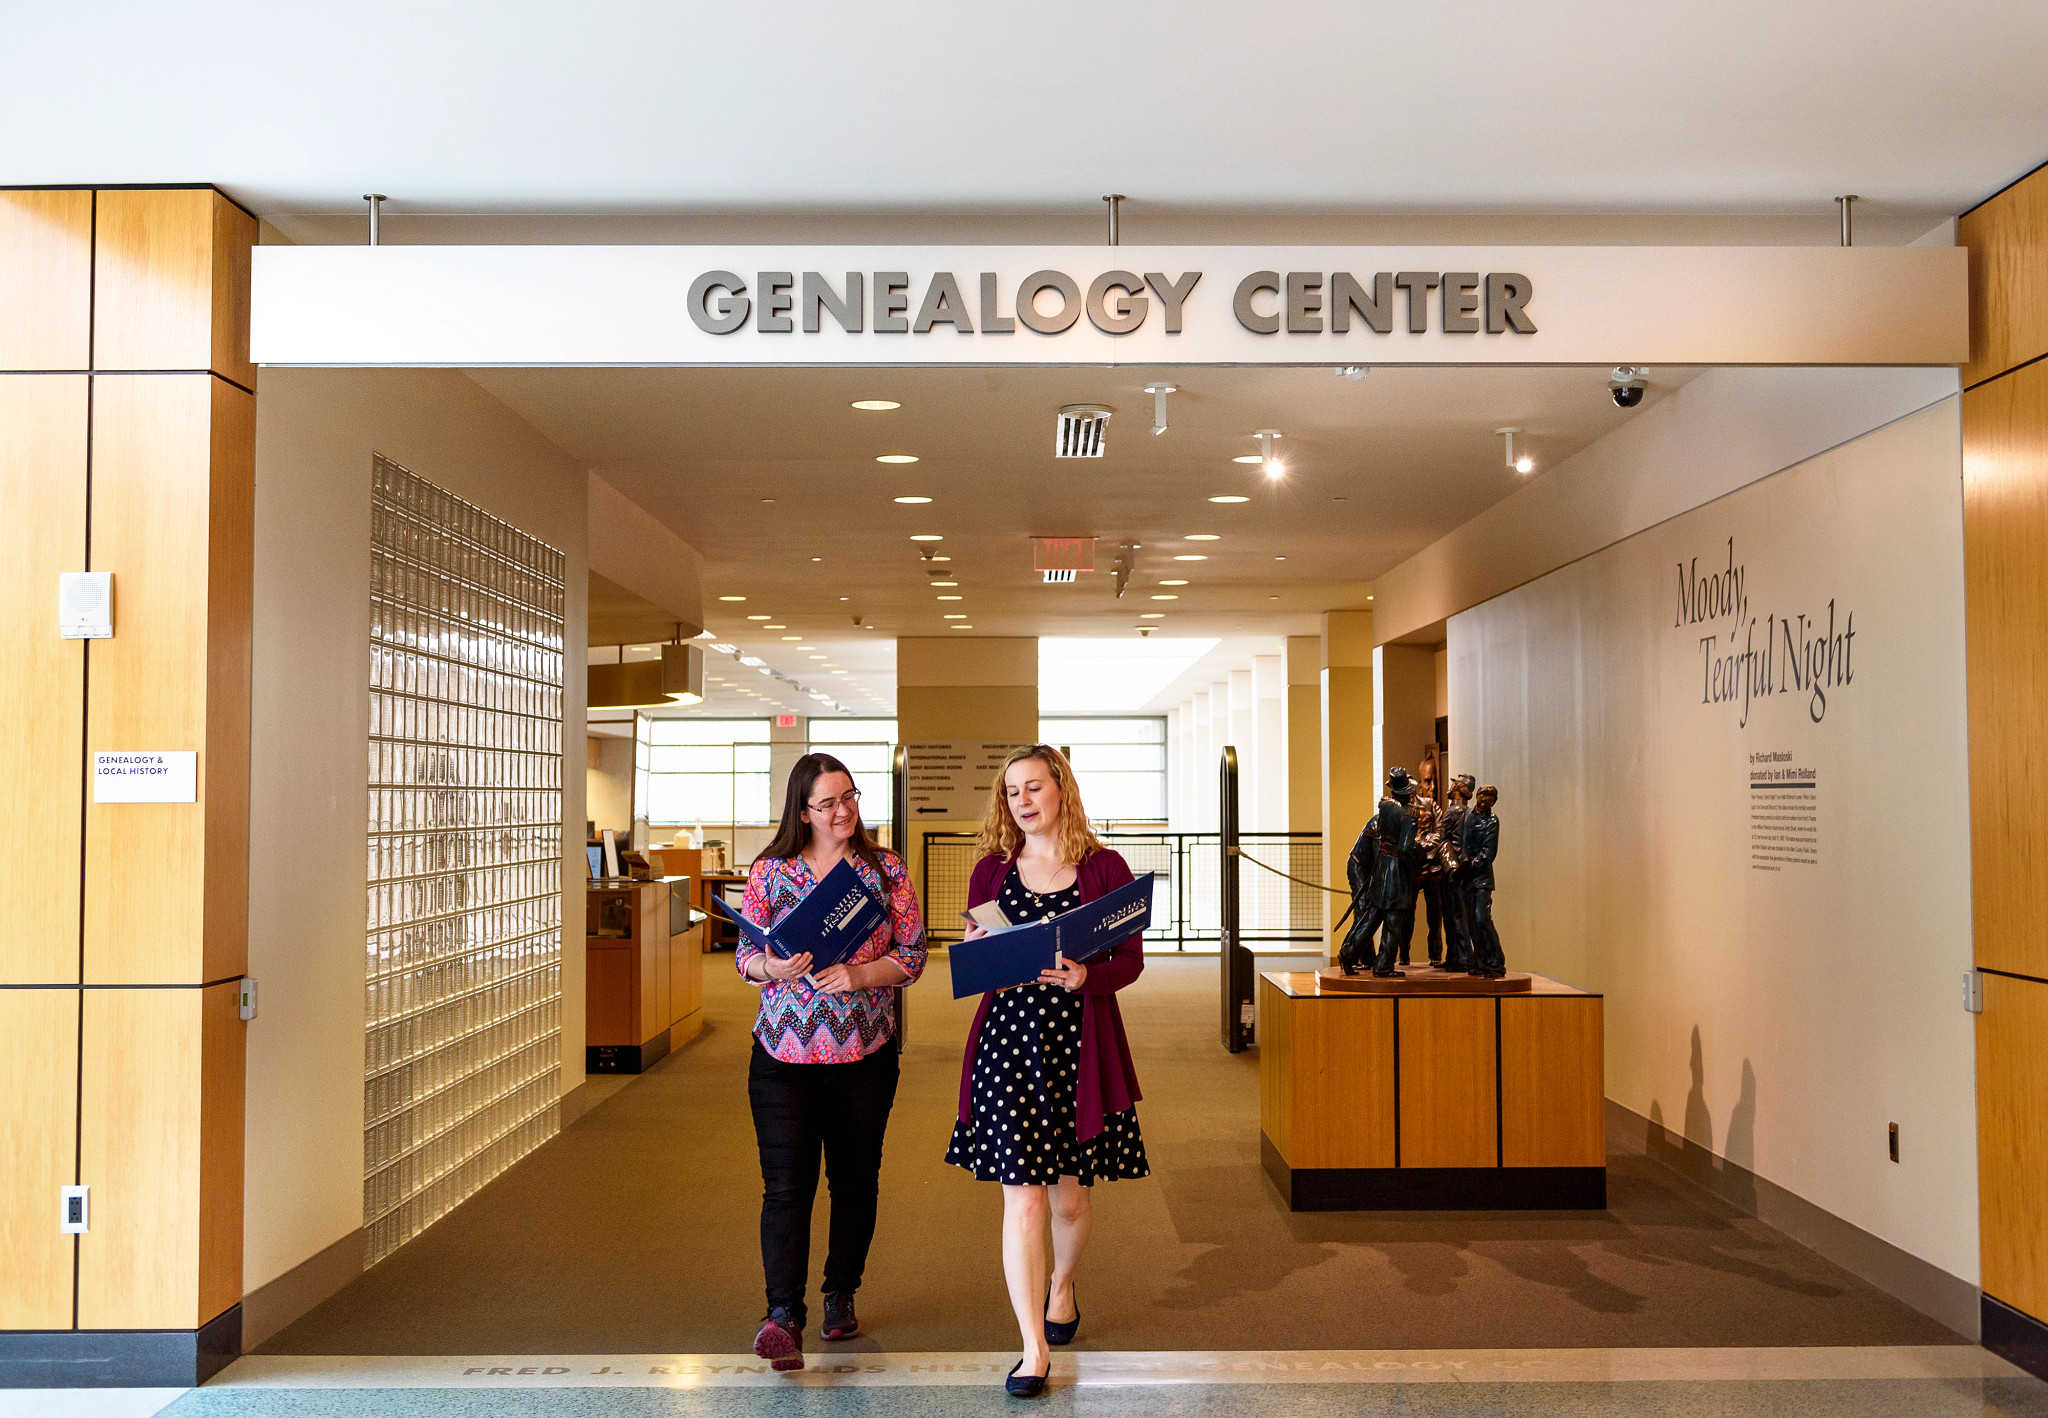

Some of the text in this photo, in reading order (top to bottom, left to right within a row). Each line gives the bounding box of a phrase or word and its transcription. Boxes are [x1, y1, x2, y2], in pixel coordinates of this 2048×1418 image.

[686, 269, 1539, 336] GENEALOGY CENTER
[1674, 535, 1748, 643] Moody,
[1699, 597, 1856, 729] Tearful Night
[98, 756, 164, 764] GENEALOGY &
[98, 767, 169, 775] LOCAL HISTORY
[820, 889, 863, 937] HISTORY
[822, 884, 858, 925] FAMILY
[462, 1366, 572, 1376] FRED
[590, 1366, 624, 1375] J.
[648, 1365, 888, 1375] REYNLDS
[1197, 1360, 1473, 1371] GENEALOGY
